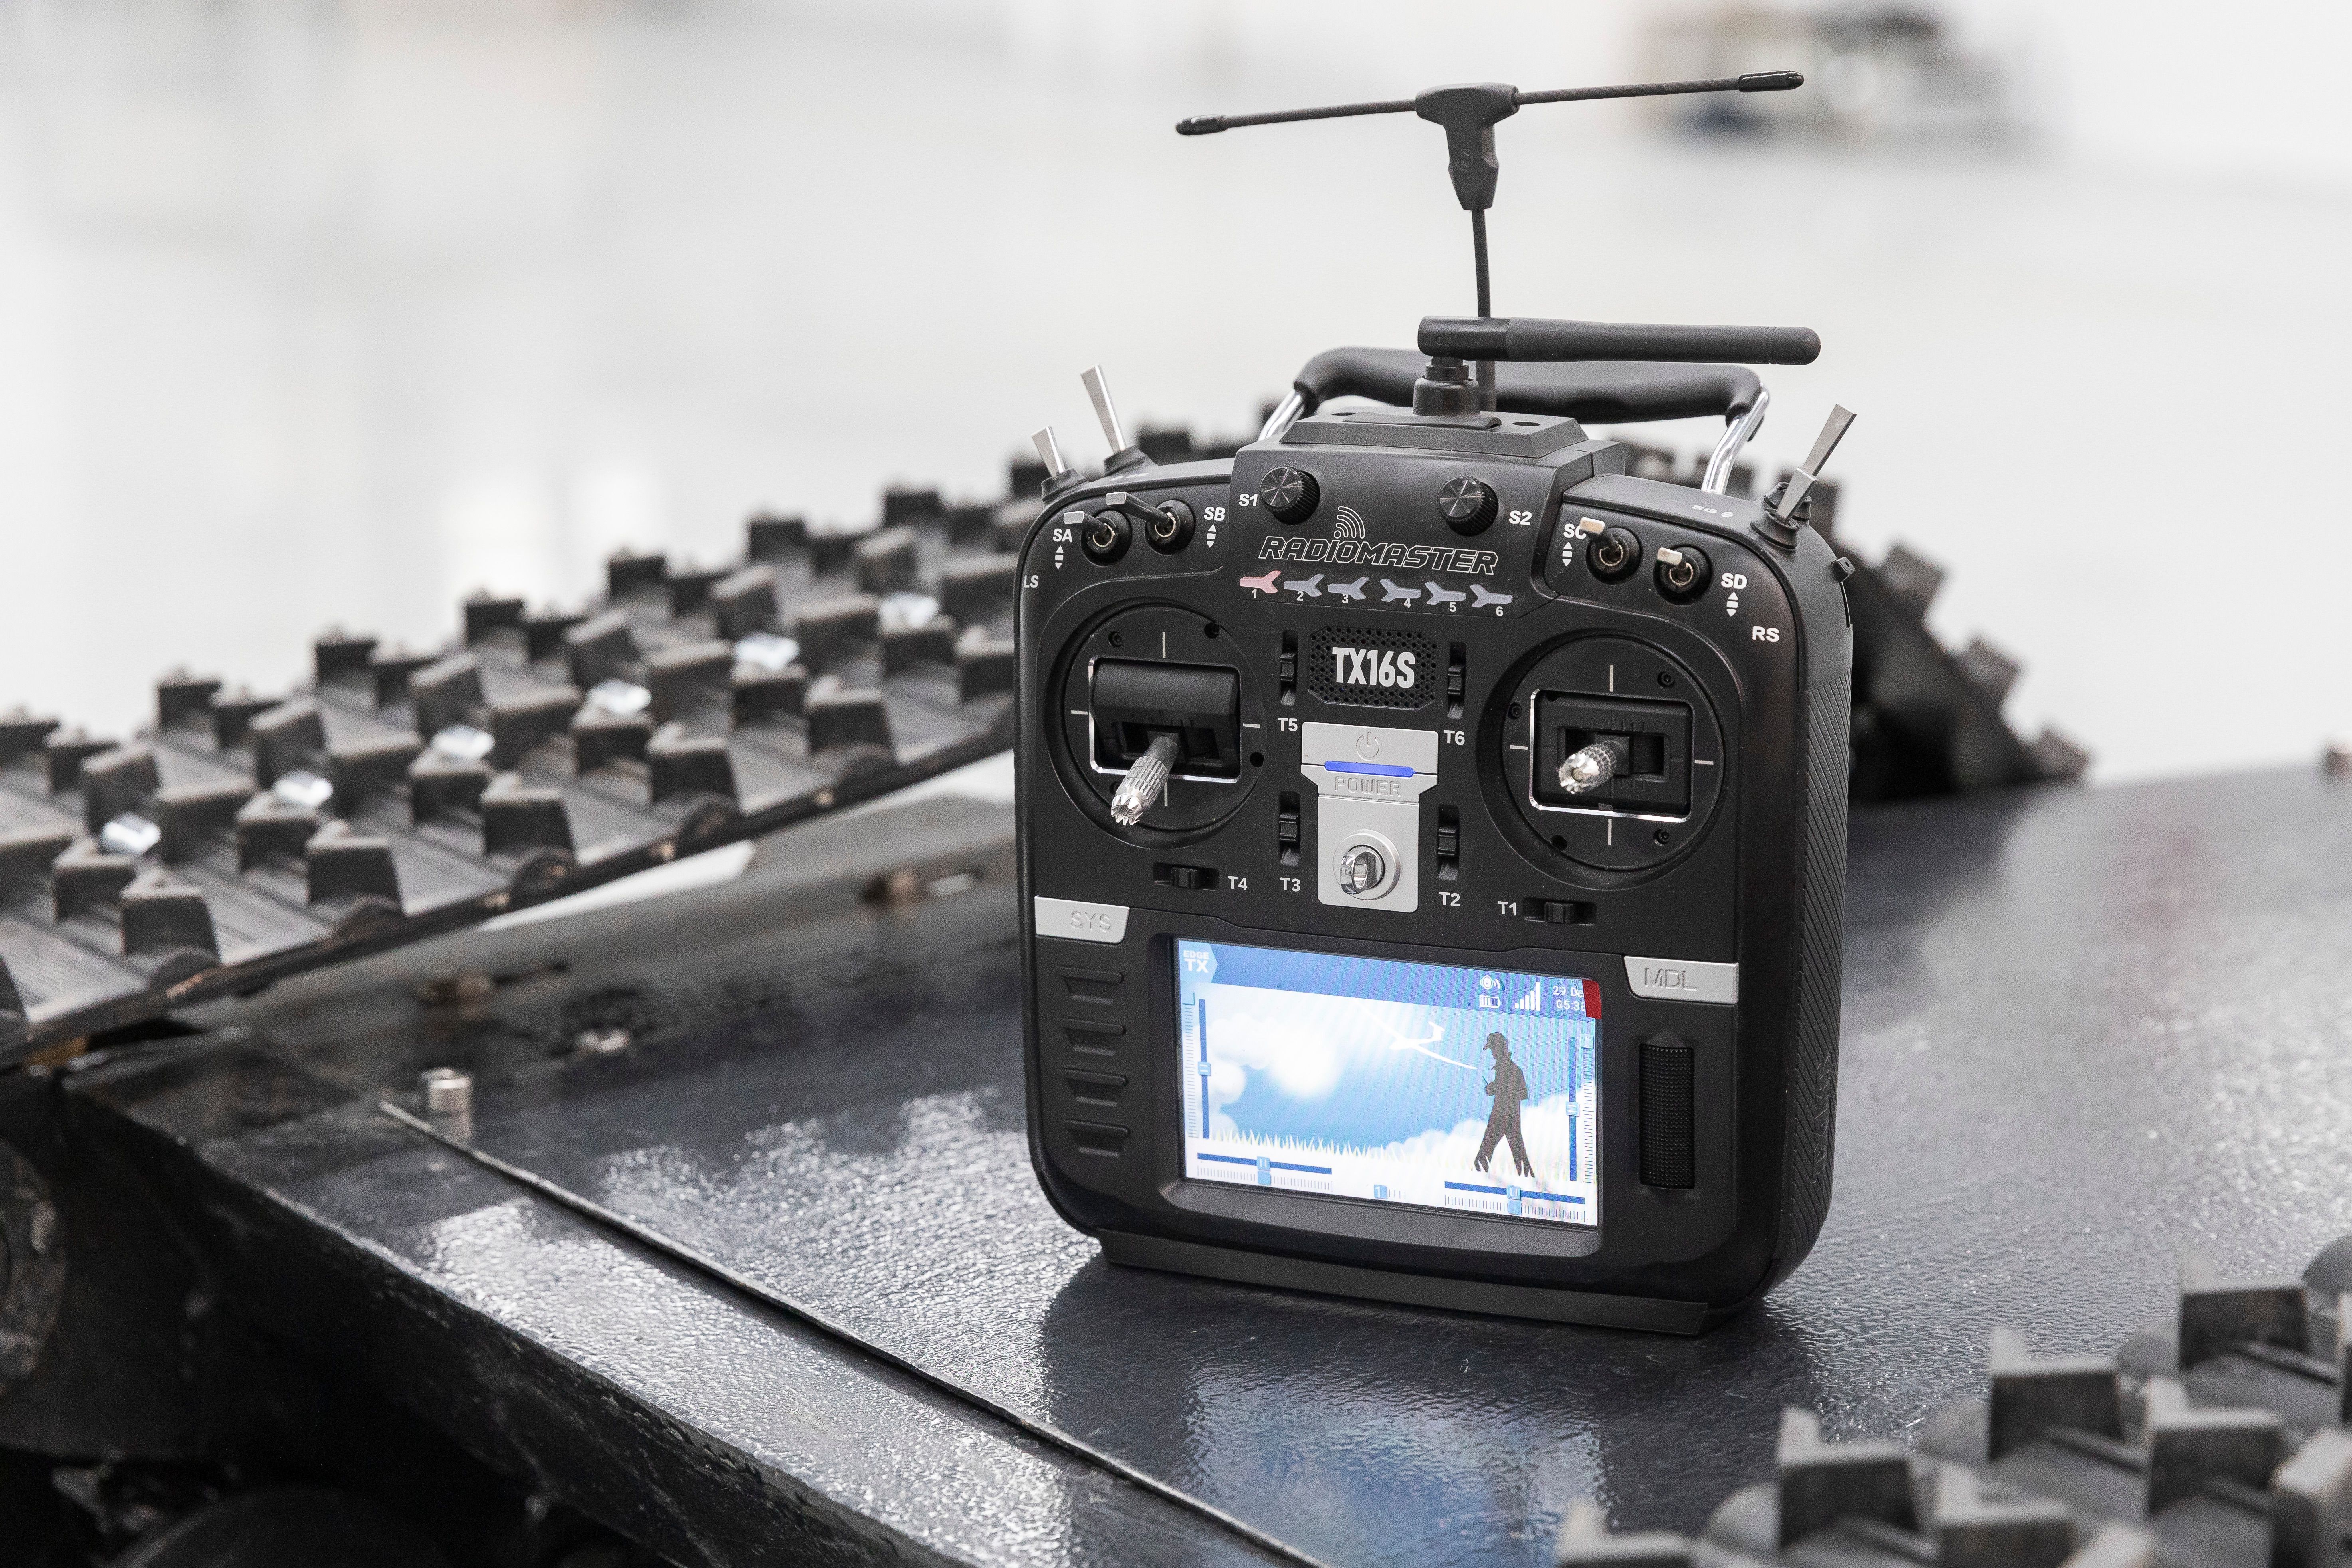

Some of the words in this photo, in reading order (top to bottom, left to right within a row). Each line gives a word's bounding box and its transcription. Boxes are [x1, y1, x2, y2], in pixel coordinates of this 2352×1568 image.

[1238, 493, 1258, 507] S1
[1203, 506, 1226, 521] SB
[1509, 510, 1532, 525] S2
[1053, 528, 1072, 543] SA
[1563, 523, 1587, 539] SC
[1258, 536, 1499, 575] RADIOMASTER
[1023, 575, 1039, 588] LS
[1721, 573, 1748, 589] SD
[1252, 588, 1257, 599] 1
[1296, 591, 1304, 601] 2
[1341, 593, 1349, 604] 3
[1403, 597, 1411, 608] 4
[1449, 601, 1457, 613] 5
[1496, 606, 1504, 617] 6
[1752, 626, 1780, 642] RS
[1332, 647, 1415, 689] TX16S
[1277, 717, 1298, 732] T5
[1443, 730, 1465, 745] T6
[1335, 776, 1401, 797] POWER
[1227, 876, 1248, 891] T4
[1280, 877, 1301, 892] T3
[1439, 892, 1460, 907] T2
[1497, 901, 1517, 916] T1
[1070, 910, 1111, 932] SYS
[1183, 950, 1209, 960] EDGE
[1184, 958, 1209, 973] TX
[1644, 967, 1697, 991] MDL
[1553, 985, 1566, 996] 29
[1571, 987, 1584, 997] De
